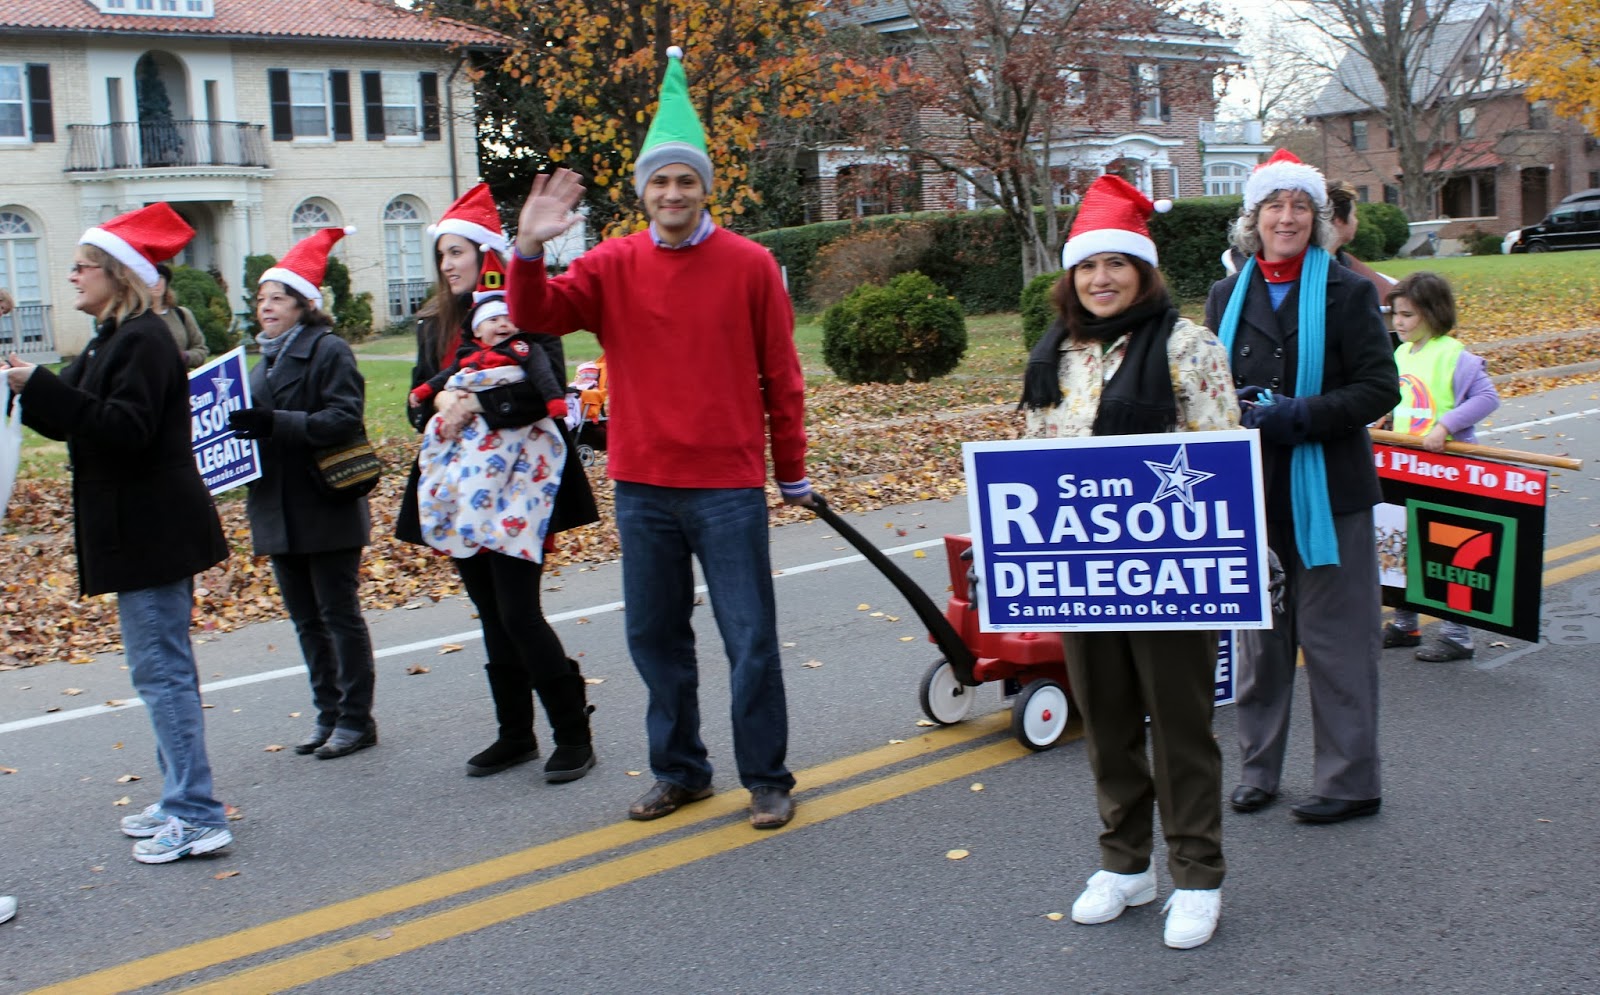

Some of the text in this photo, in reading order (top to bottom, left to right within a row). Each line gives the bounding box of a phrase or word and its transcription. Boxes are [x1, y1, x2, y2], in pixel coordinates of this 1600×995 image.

[189, 391, 213, 412] Sam
[195, 436, 252, 475] LEGATE
[1391, 451, 1460, 481] Place
[1465, 464, 1498, 488] To
[1504, 471, 1541, 495] Be
[1057, 474, 1134, 499] Sam
[987, 482, 1245, 545] RASOUL
[993, 556, 1250, 598] DELEGATE
[1429, 521, 1493, 613] 7
[1008, 600, 1240, 617] Sam4Roanoke.com
